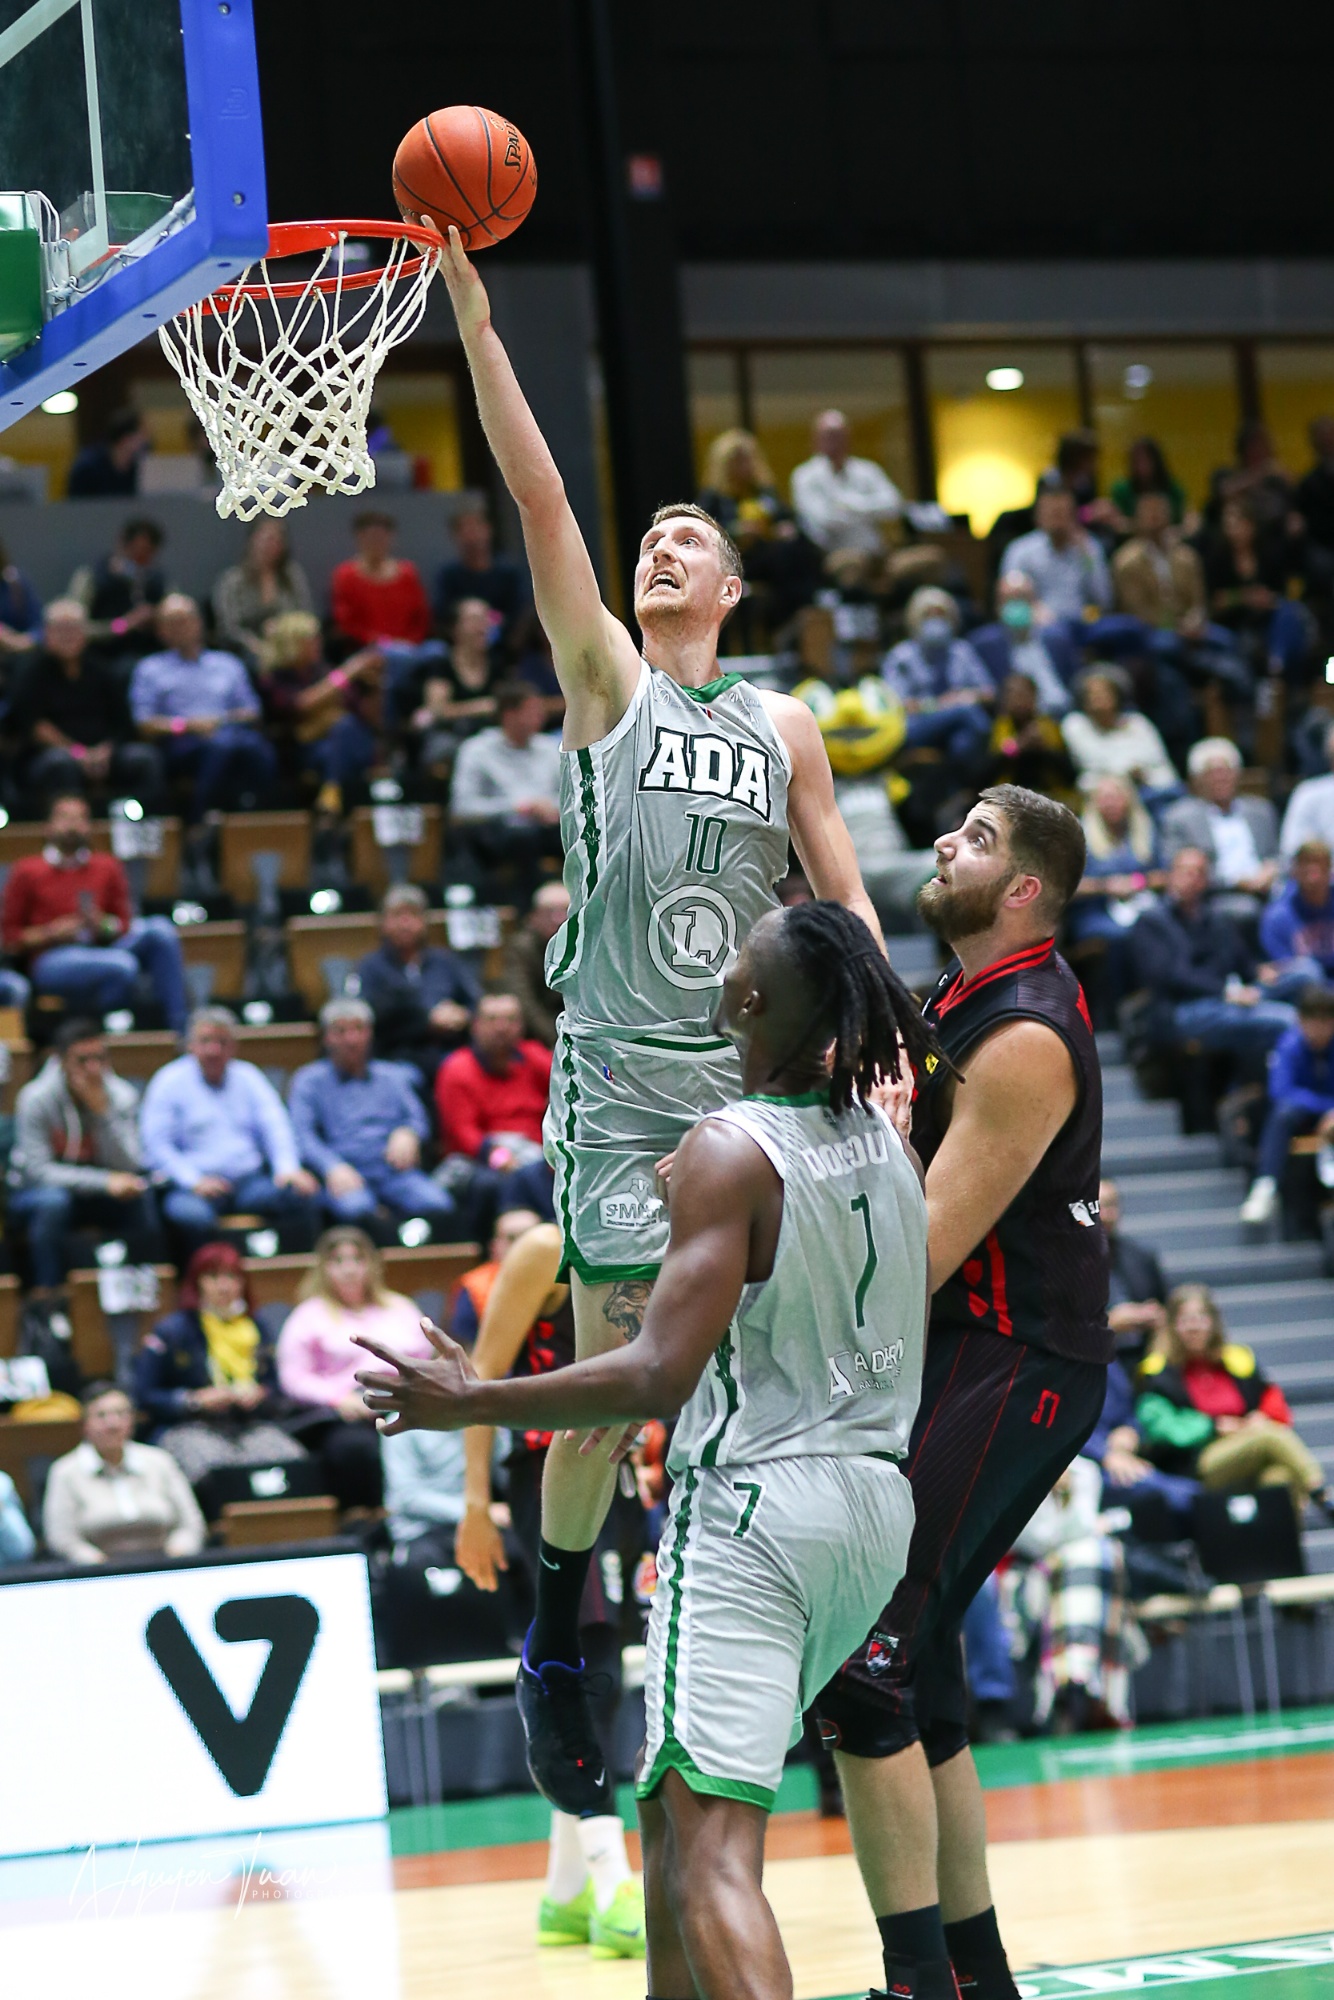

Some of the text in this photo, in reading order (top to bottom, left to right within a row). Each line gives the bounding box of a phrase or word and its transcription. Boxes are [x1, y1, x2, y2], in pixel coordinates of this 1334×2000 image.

[637, 726, 772, 824] ADA
[685, 811, 728, 876] 10
[732, 1480, 764, 1539] 7
